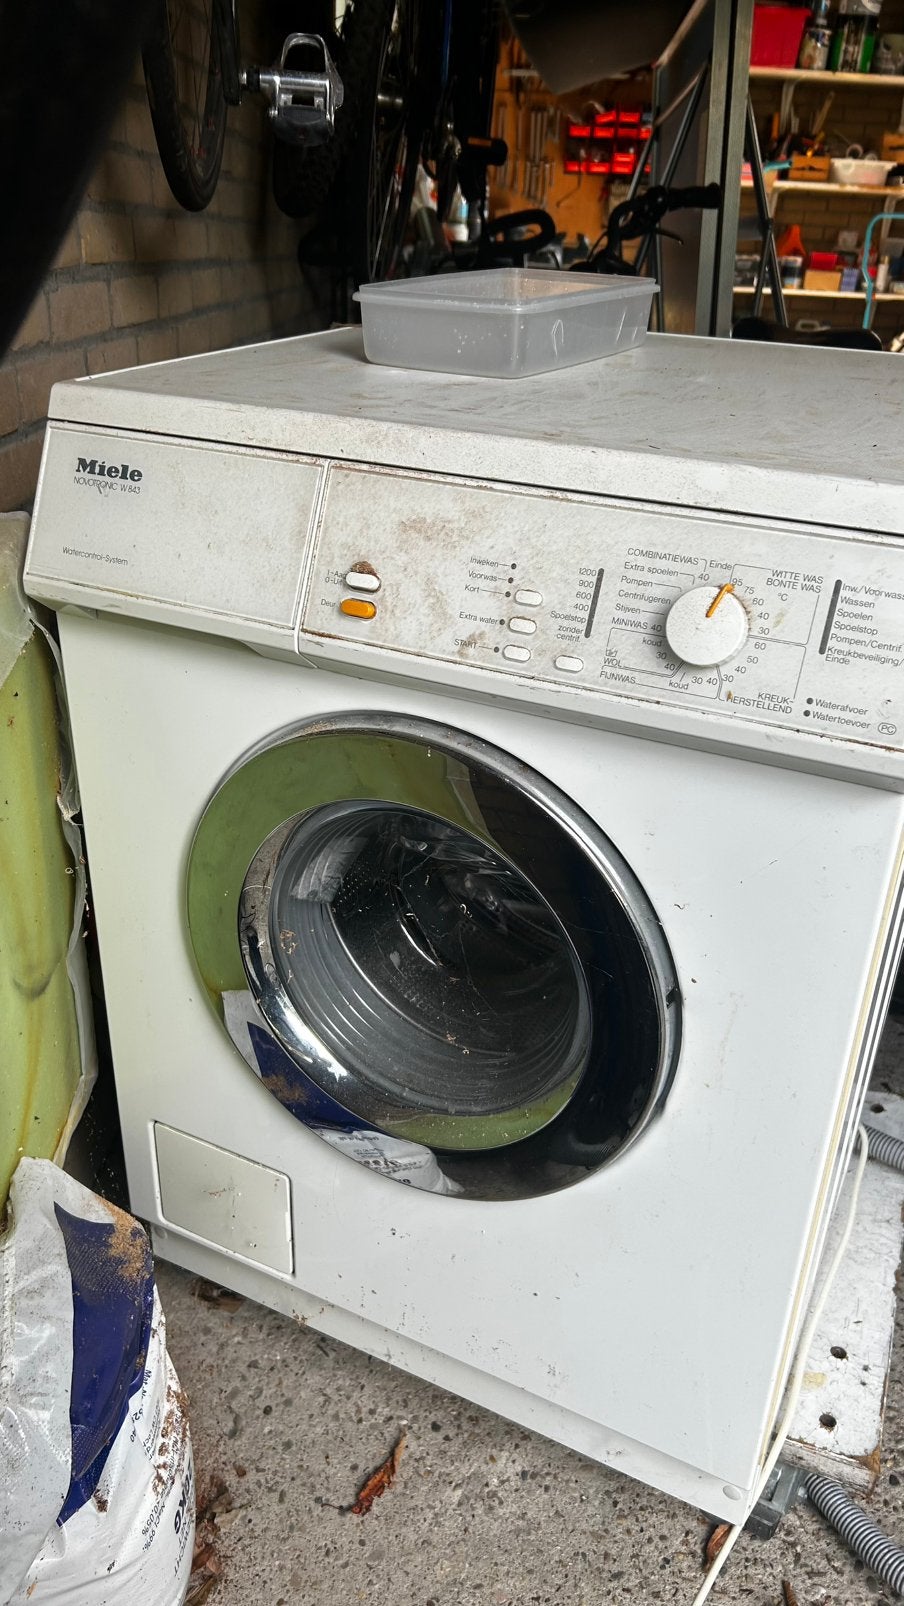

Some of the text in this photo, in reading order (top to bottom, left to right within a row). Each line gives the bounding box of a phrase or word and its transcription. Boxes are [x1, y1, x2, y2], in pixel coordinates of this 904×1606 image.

[76, 457, 143, 482] Miele
[74, 476, 118, 491] NOVOTRONIC
[470, 556, 499, 568] Inweken
[627, 547, 699, 566] COMBINATIEWAS
[624, 561, 679, 577] Extra spoelen
[709, 560, 733, 571] Einde
[468, 570, 498, 582] Voorwas
[578, 567, 597, 577] 1200
[698, 573, 710, 581] 40
[771, 569, 824, 585] WITTE WAS
[578, 579, 595, 589] 900
[620, 575, 653, 588] Pompen
[732, 577, 743, 586] 95
[766, 577, 822, 594] BONTE WAS
[464, 584, 480, 594] Kort
[744, 586, 755, 595] 75
[575, 591, 592, 600] 600
[618, 589, 672, 605] Centrifugeren
[752, 597, 764, 606] 60
[840, 596, 875, 608] Wassen
[573, 603, 590, 612] 400
[615, 602, 641, 614] Stijven
[459, 611, 499, 625] Extra water
[550, 610, 587, 624] Spoelstop
[757, 612, 770, 620] 40
[837, 608, 873, 621] Spoelen
[558, 624, 584, 635] zonder
[611, 616, 663, 632] MINIWAS 40
[833, 620, 878, 636] Spoelstop
[758, 626, 770, 635] 30
[454, 638, 477, 650] START
[641, 637, 662, 647] koud
[754, 642, 767, 651] 60
[655, 651, 667, 660] 30
[746, 656, 759, 664] 50
[825, 654, 850, 665] Einde
[603, 657, 622, 667] WOL
[664, 663, 676, 671] 40
[734, 665, 747, 674] 40
[599, 670, 637, 685] FIJNWAS
[691, 676, 718, 686] 30 40
[723, 674, 735, 683] 30
[668, 679, 689, 690] koud
[757, 692, 794, 705] KREUK-
[815, 698, 869, 716] Waterafvoer
[812, 711, 872, 730] Watertoevoer
[880, 724, 895, 735] PC
